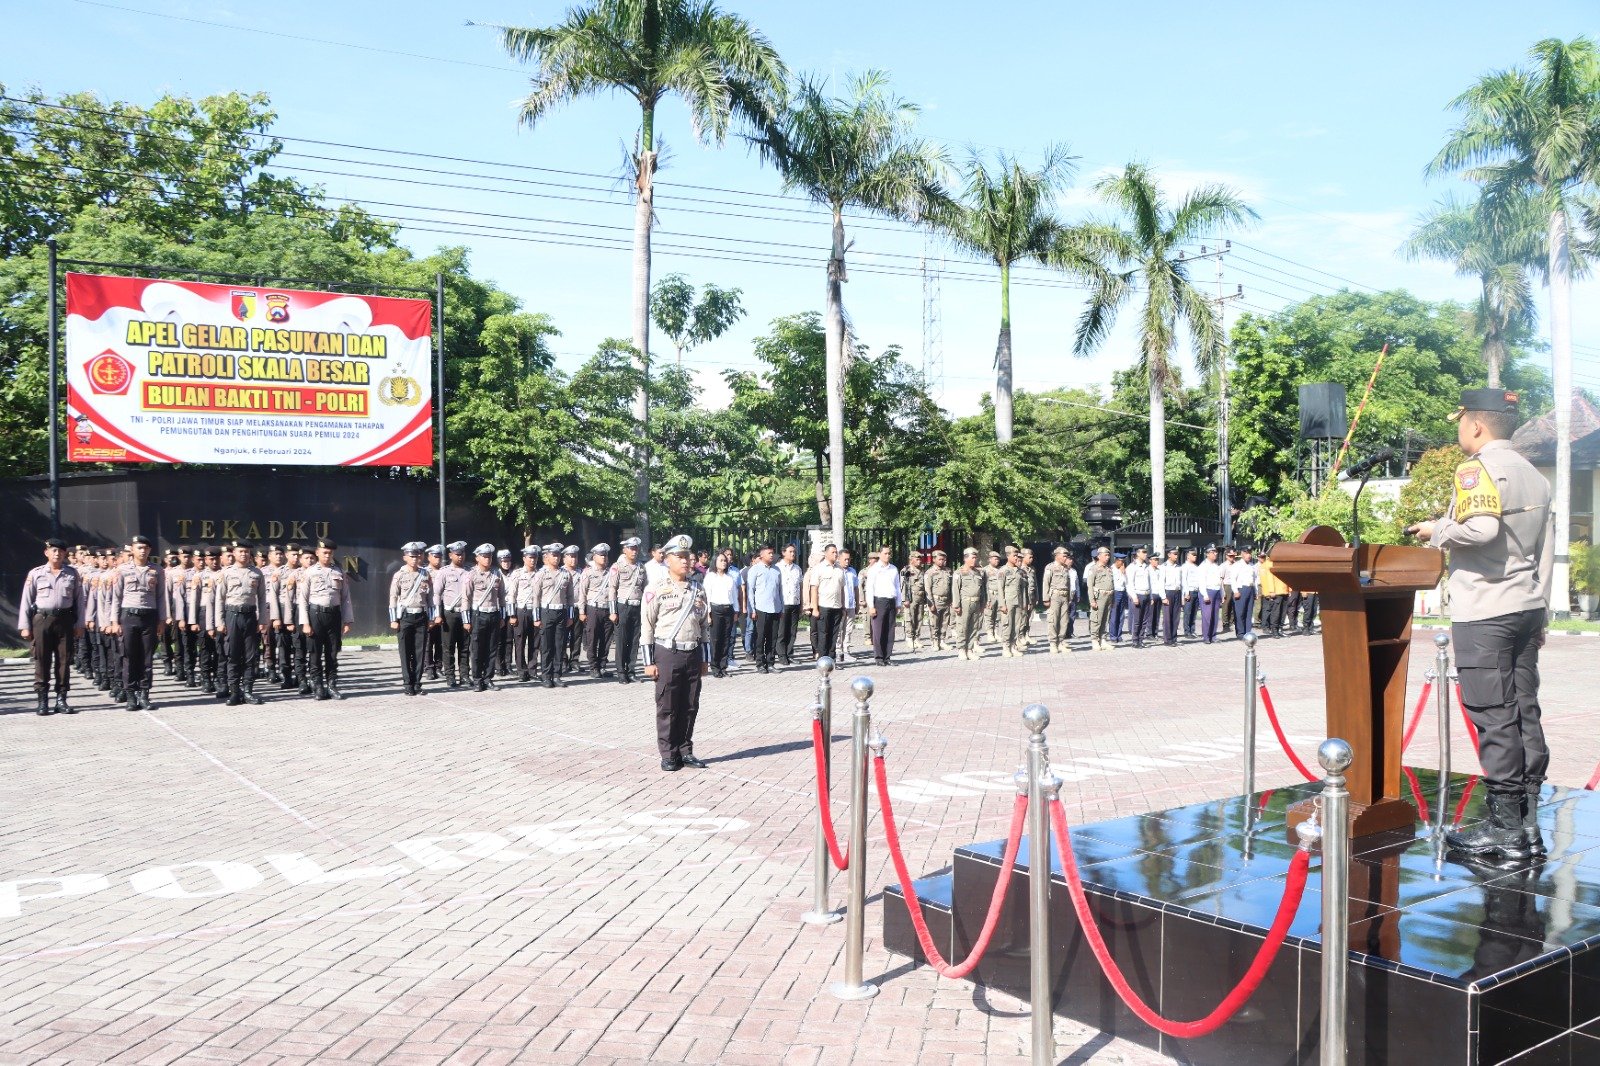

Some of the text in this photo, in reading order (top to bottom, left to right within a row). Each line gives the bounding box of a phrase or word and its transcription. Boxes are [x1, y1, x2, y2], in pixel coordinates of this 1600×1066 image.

[126, 320, 387, 359] APEL GELAR PASUKAN DAN
[148, 351, 370, 385] PATROLI SKALA BESAR
[147, 385, 210, 407] BULAN
[214, 388, 269, 409] BAKTI
[272, 390, 301, 410] TNI
[315, 391, 364, 412] POLRI
[131, 415, 144, 423] TNI
[152, 416, 174, 424] POLRI
[177, 417, 198, 425] JAWA
[201, 418, 224, 426] TIMUR
[227, 418, 243, 426] SIAP
[246, 419, 303, 428] MELAKSANAKAN
[305, 421, 352, 429] PENGAMANAN
[355, 422, 384, 430] TAHAPAN
[160, 427, 212, 435] PEMUNGUTAN
[215, 428, 229, 436] DAN
[232, 429, 287, 437] PENGHITUNGAN
[290, 430, 312, 438] SUARA
[73, 448, 126, 456] PRESISI
[214, 447, 250, 455] Nganjuk,
[177, 519, 331, 540] TEKADKU
[0, 807, 750, 917] POLRES
